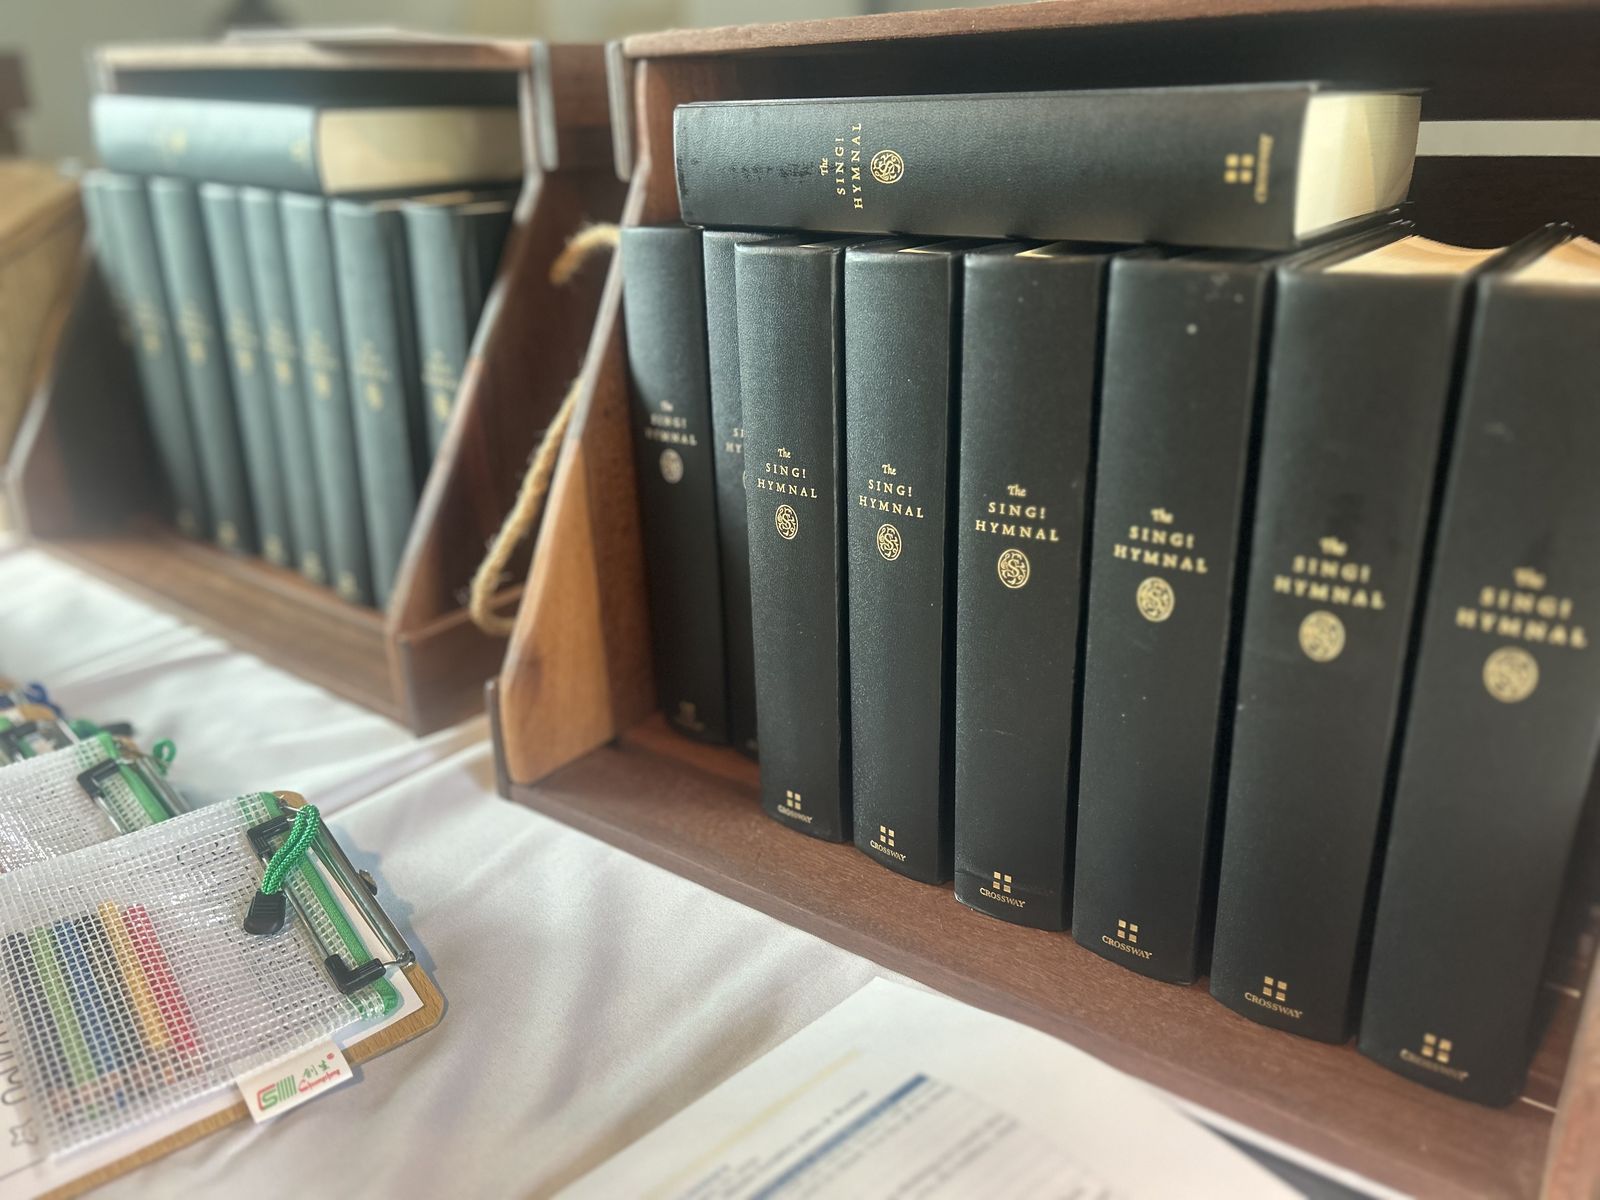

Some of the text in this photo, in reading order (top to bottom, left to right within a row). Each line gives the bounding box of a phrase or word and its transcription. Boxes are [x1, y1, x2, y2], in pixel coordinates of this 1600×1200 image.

[820, 157, 829, 176] The
[835, 137, 846, 195] SING!
[851, 123, 863, 209] HYMNAL
[777, 447, 791, 459] The
[765, 462, 807, 479] SING!
[881, 463, 897, 476] The
[756, 478, 818, 499] HYMNAL
[867, 479, 913, 497] SING!
[1007, 484, 1027, 498] The
[858, 495, 924, 519] HYMNAL
[988, 502, 1047, 520] SING!
[1150, 507, 1175, 525] The
[975, 519, 1060, 542] HYMNAL
[1128, 525, 1196, 549] SING!
[1113, 543, 1209, 574] HYMNAL
[1273, 575, 1386, 610] HYMNAL
[870, 839, 907, 862] CROSSWAY
[979, 887, 1026, 909] CROSSWAY
[1101, 935, 1153, 961] CROSSWAY
[1244, 991, 1303, 1020] CROSSWAY
